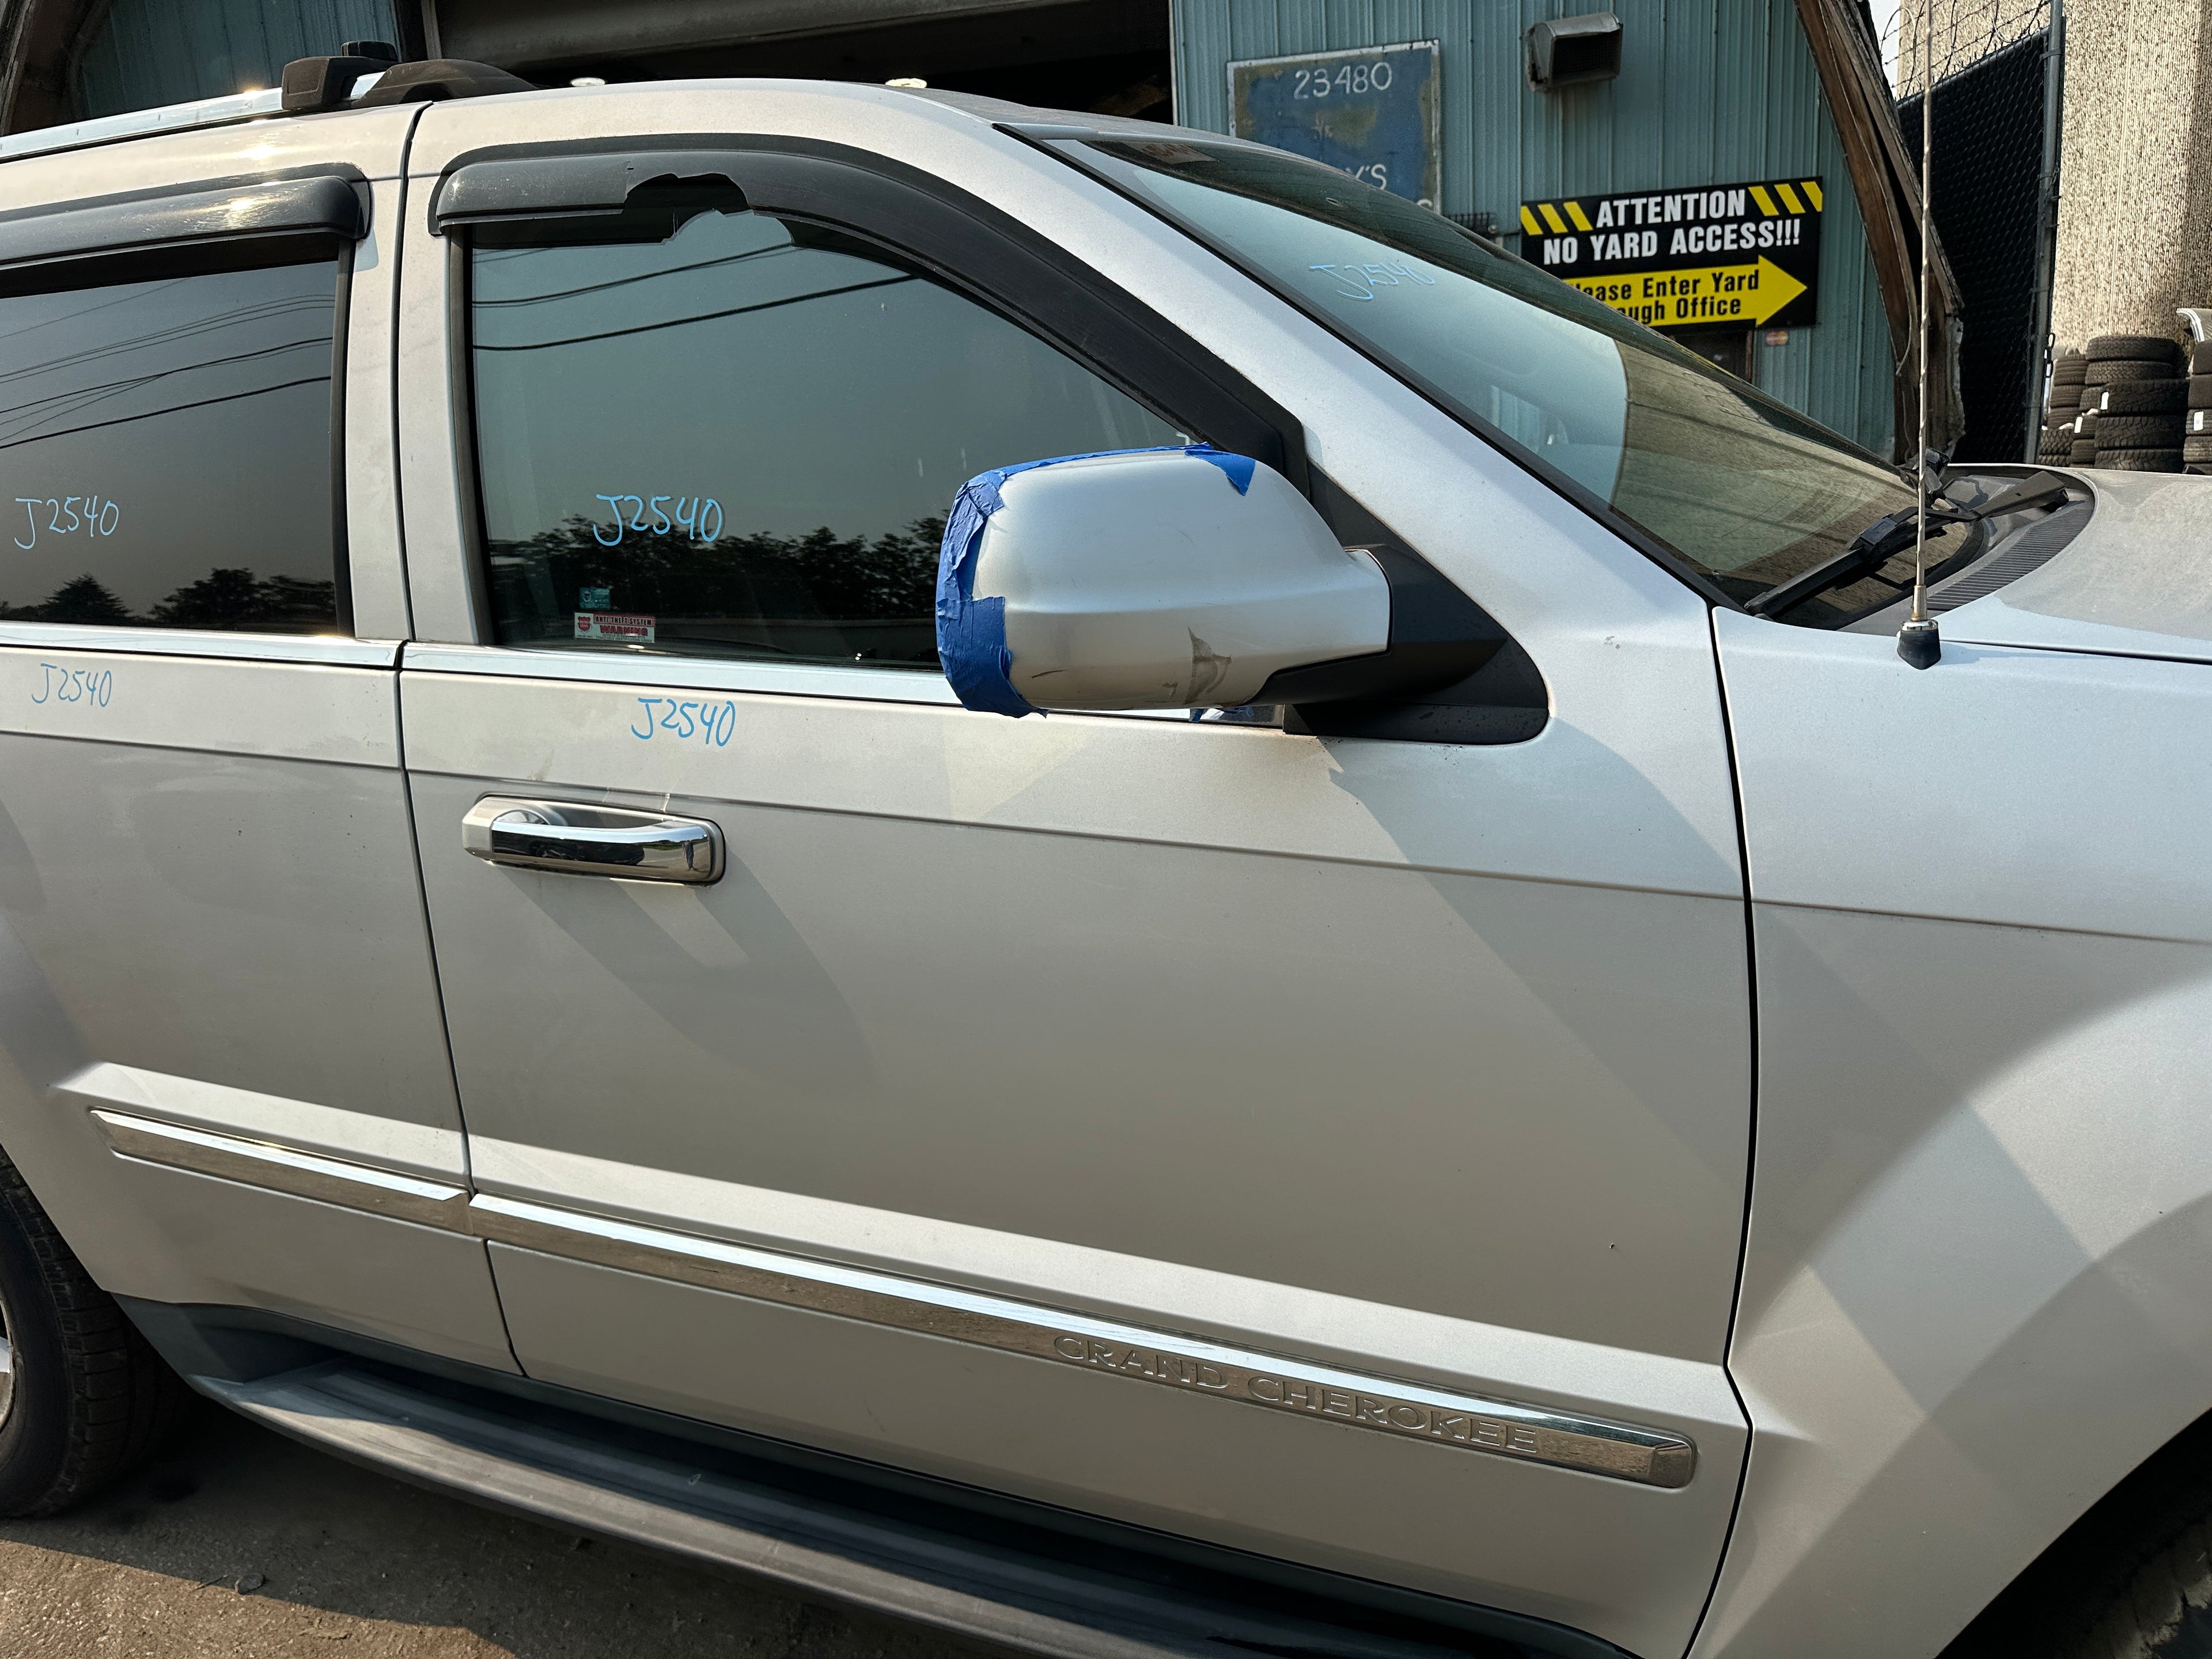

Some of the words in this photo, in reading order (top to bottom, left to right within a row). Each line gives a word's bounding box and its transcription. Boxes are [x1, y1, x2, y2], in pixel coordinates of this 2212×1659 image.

[1293, 62, 1392, 100] 23480
[1596, 189, 1745, 228] ATTENTION
[1543, 237, 1578, 266] NO
[1590, 230, 1657, 261] YARD
[1670, 218, 1801, 255] ACCESS!!!
[1643, 276, 1700, 298] Enter
[1711, 270, 1759, 293] Yard
[1676, 297, 1741, 319] Office
[14, 495, 119, 550] J2540
[593, 494, 722, 546] J2540
[600, 625, 648, 636] WARNING
[630, 618, 652, 626] SYSTEM
[32, 663, 112, 707] J2540
[631, 698, 736, 747] J2540
[1054, 1336, 1229, 1389] GRAND
[1248, 1376, 1536, 1453] CHEROKEE
